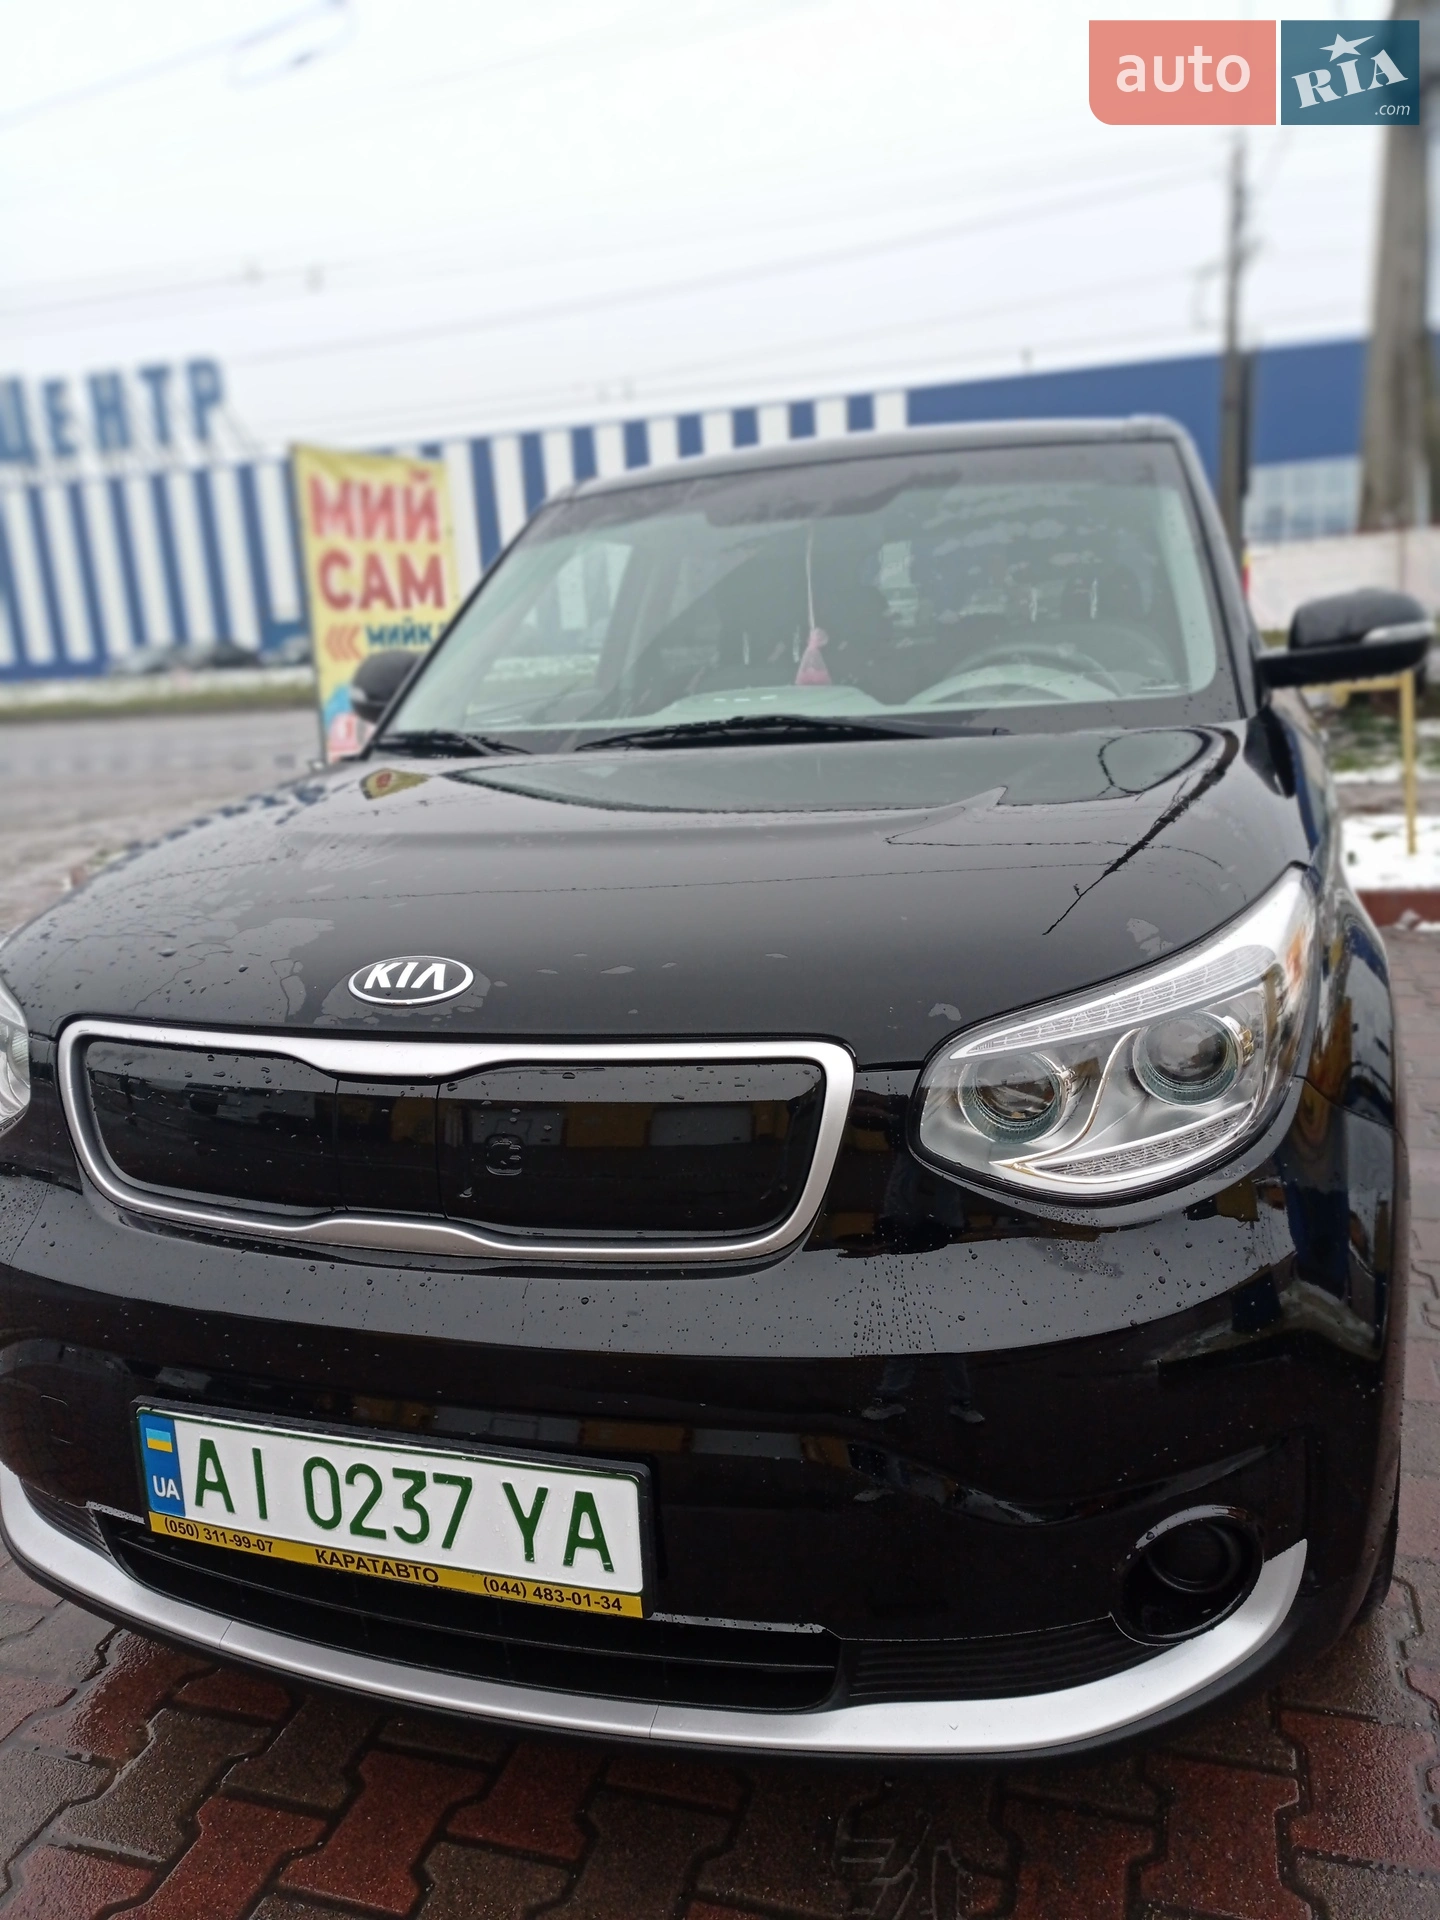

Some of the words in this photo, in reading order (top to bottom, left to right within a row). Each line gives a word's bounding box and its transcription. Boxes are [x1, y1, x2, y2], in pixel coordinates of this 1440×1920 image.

[308, 466, 441, 544] МИЙ
[317, 547, 446, 612] САМ
[365, 616, 449, 646] МИЙК
[363, 961, 446, 991] KIA
[153, 1475, 180, 1500] UA
[195, 1437, 268, 1520] AI
[303, 1456, 473, 1550] 0237
[502, 1482, 615, 1572] YA
[164, 1517, 200, 1540] (050)
[203, 1528, 273, 1554] 311-99-07
[315, 1549, 439, 1583] КАРАТАВТО
[483, 1577, 527, 1598] (044)
[533, 1586, 622, 1612] 483-01-34
